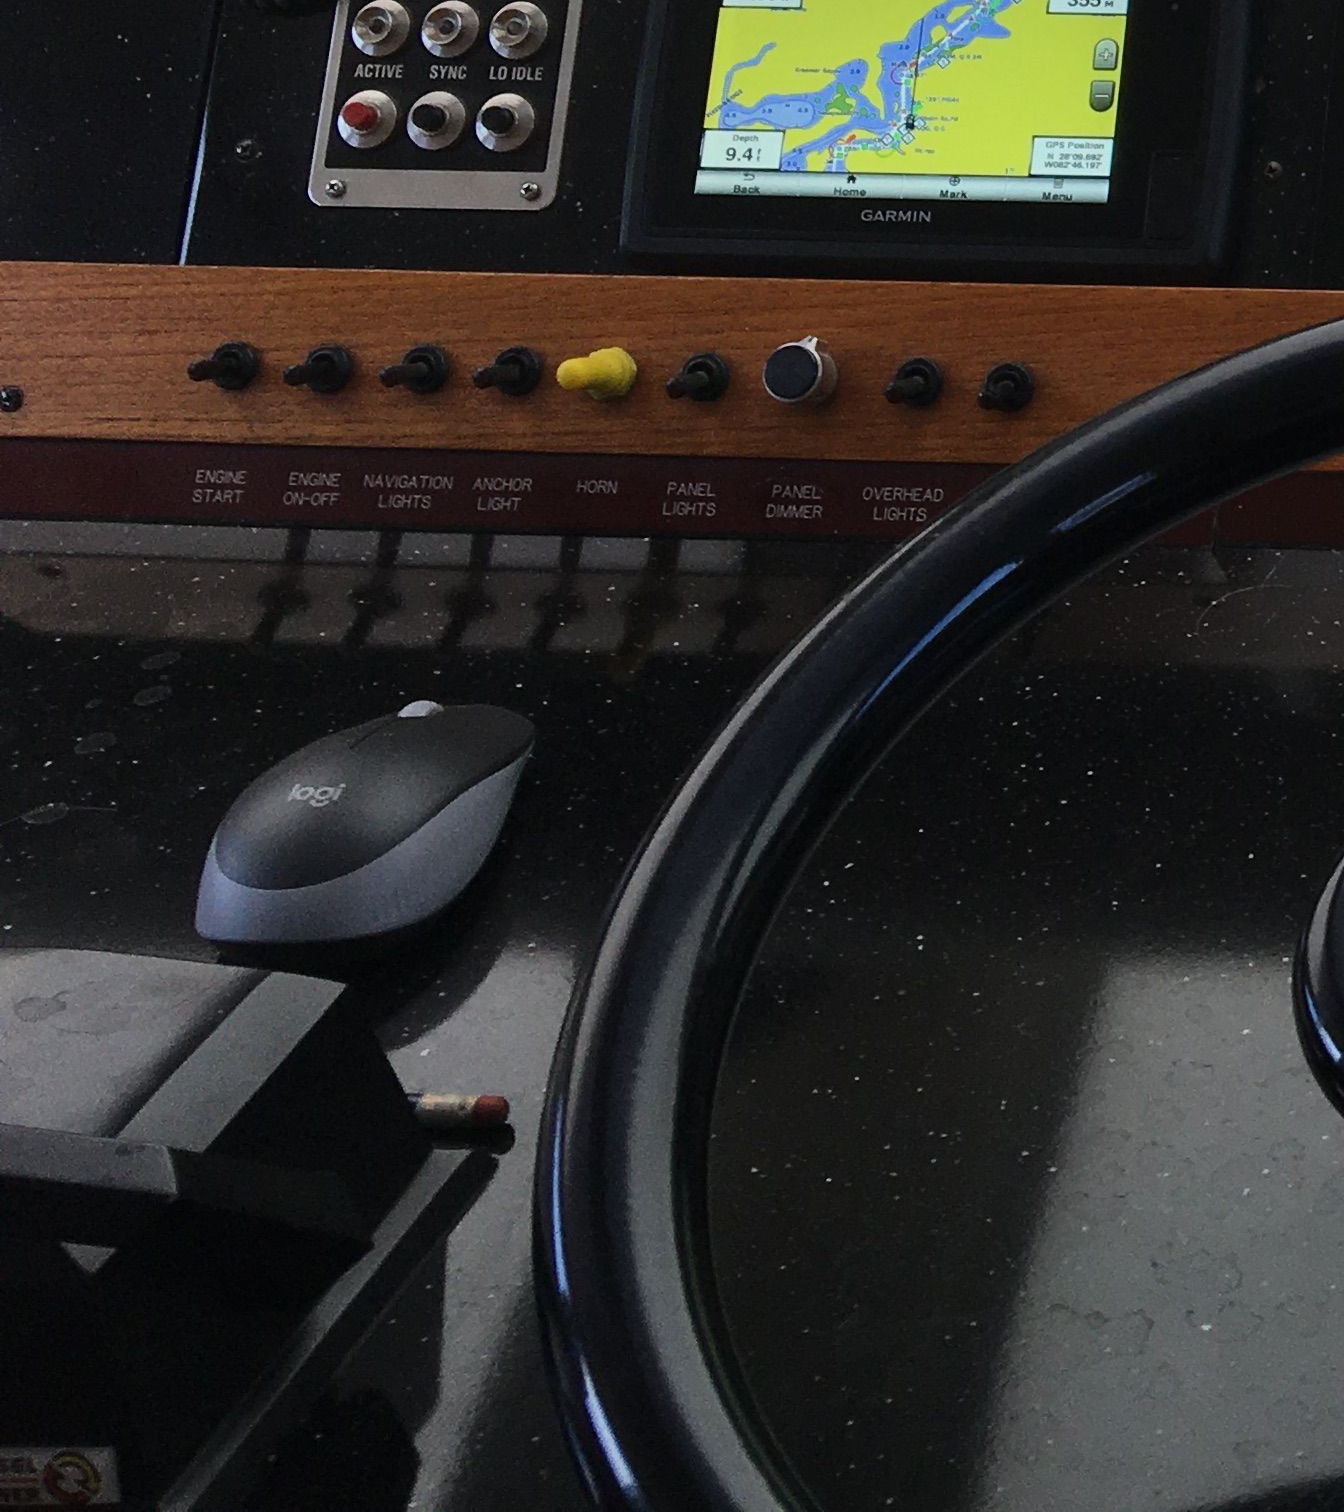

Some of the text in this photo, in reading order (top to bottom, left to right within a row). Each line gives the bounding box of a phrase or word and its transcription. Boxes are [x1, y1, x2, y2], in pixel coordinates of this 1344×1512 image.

[354, 64, 404, 78] ACTIVE
[429, 65, 467, 79] SYNC
[489, 66, 544, 81] LO IDLE
[733, 134, 758, 143] Depth
[861, 209, 931, 222] GARMIN
[195, 469, 247, 485] ENGINE
[289, 472, 341, 487] ENGINE
[363, 474, 454, 490] NAVIGATION
[472, 477, 533, 492] ANCHOR
[576, 479, 618, 495] HORN
[667, 481, 716, 498] PANEL
[771, 484, 821, 500] PANEL
[862, 486, 944, 502] OVERHEAD
[192, 488, 244, 504] START
[283, 491, 340, 506] ON-OFF
[377, 494, 432, 510] LIGHTS
[477, 496, 521, 512] LIGHT
[662, 500, 716, 517] LIGHTS
[765, 503, 823, 519] DIMMER
[873, 506, 927, 522] LIGHTS
